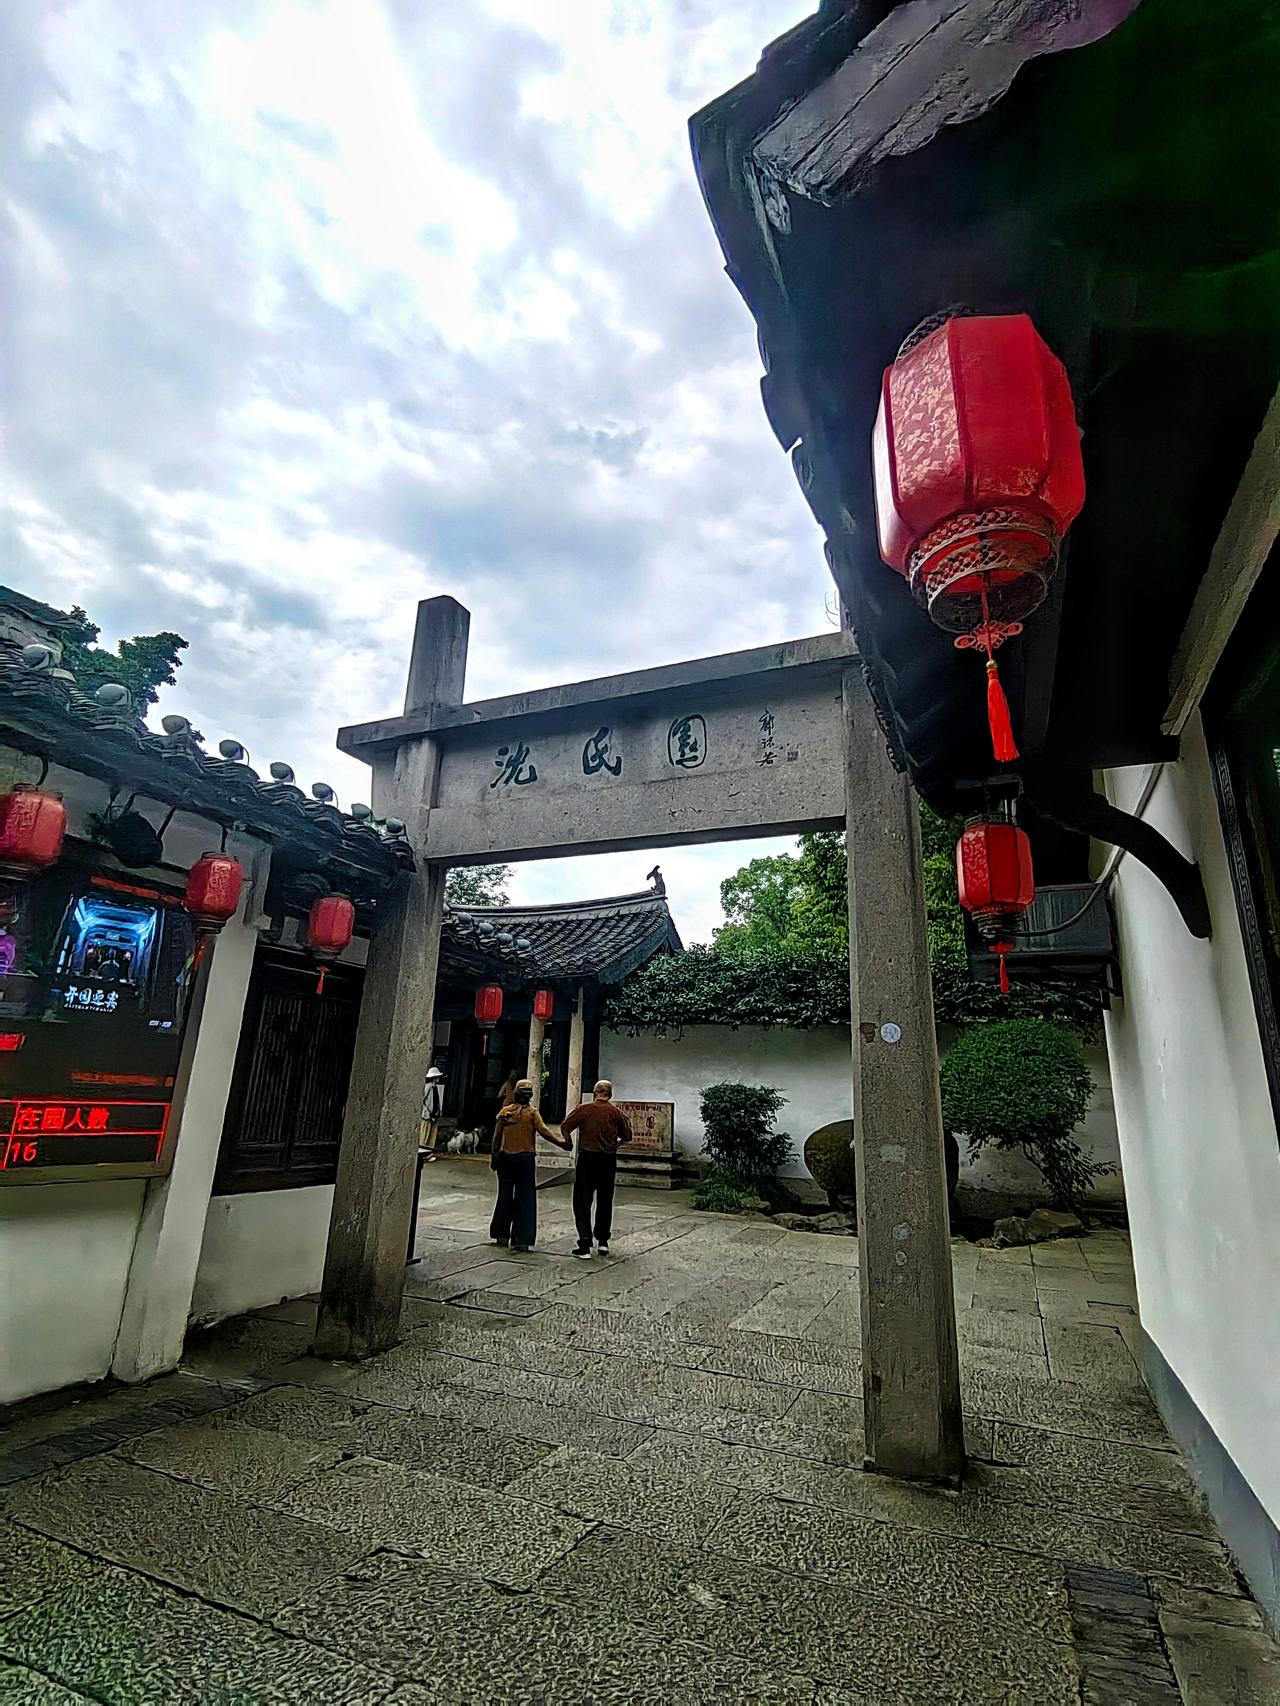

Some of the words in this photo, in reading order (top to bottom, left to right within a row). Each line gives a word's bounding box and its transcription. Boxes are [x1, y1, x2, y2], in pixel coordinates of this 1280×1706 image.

[16, 1107, 110, 1131] 在园人数
[12, 1142, 38, 1162] 16
